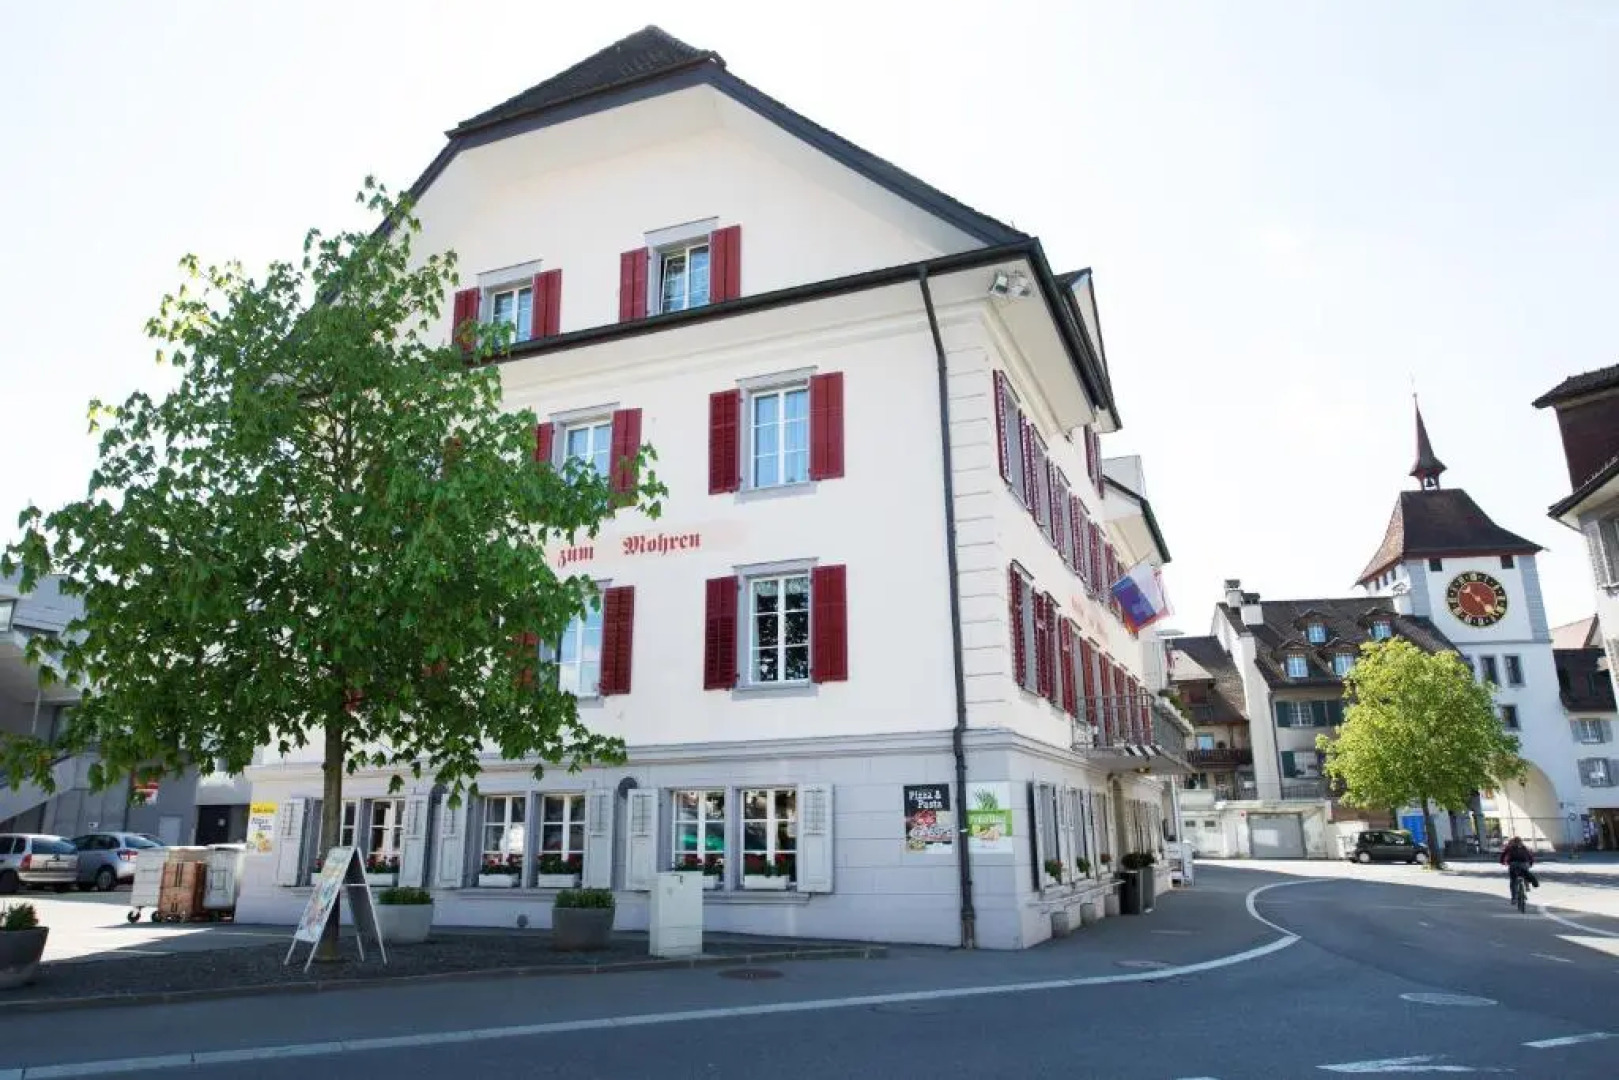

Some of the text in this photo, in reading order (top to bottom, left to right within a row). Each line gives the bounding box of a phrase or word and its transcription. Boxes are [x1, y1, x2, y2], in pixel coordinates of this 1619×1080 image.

[558, 532, 702, 568] zum Mohren
[908, 790, 942, 800] Pizza &
[917, 799, 943, 809] Pasta
